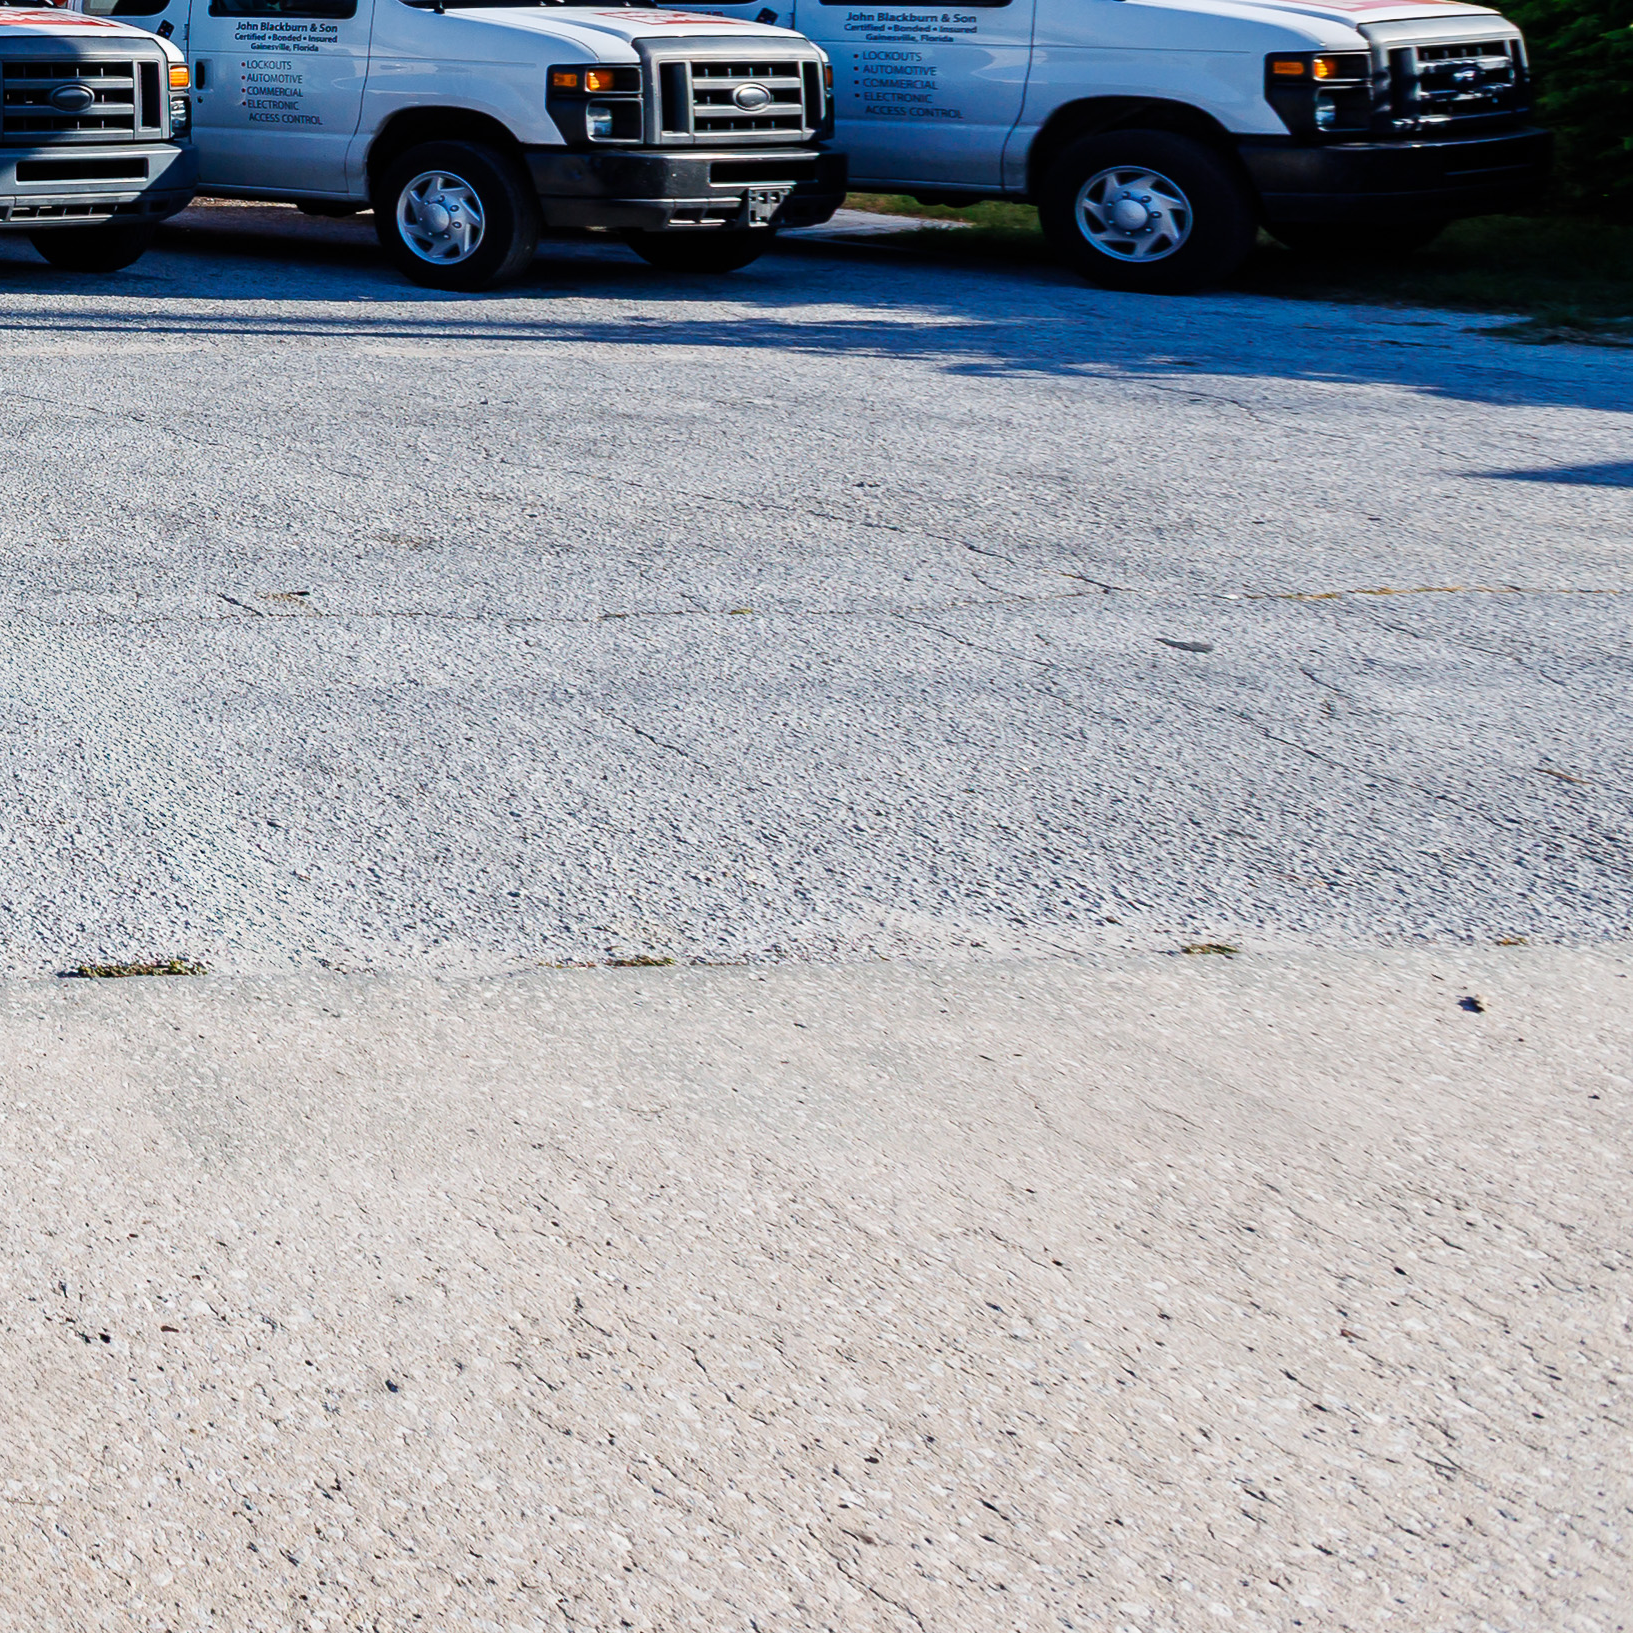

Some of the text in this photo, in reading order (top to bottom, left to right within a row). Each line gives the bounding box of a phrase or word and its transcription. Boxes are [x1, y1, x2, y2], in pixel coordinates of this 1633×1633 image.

[846, 12, 977, 23] John Blackburn & Son
[236, 22, 338, 33] John Blackburn & Son
[844, 23, 977, 34] Certified Bonded Insured
[234, 33, 337, 43] Certified Bonded Insured
[865, 33, 954, 42] Gainesville, Florida
[251, 43, 319, 52] Gainesville, Florida
[863, 51, 922, 62] LOCKOUTS
[246, 60, 292, 70] LOCKOUTS
[863, 65, 937, 76] AUTOMOTIVE
[246, 73, 303, 84] AUTOMOTIVE
[863, 78, 939, 90] COMMERCIAL
[246, 86, 303, 97] COMMERCIAL
[863, 92, 933, 104] ELECTRONIC
[247, 99, 299, 110] ELECTRONIC
[865, 105, 964, 119] ACCESS CONTROL
[249, 113, 323, 125] ACCESS CONTROL
